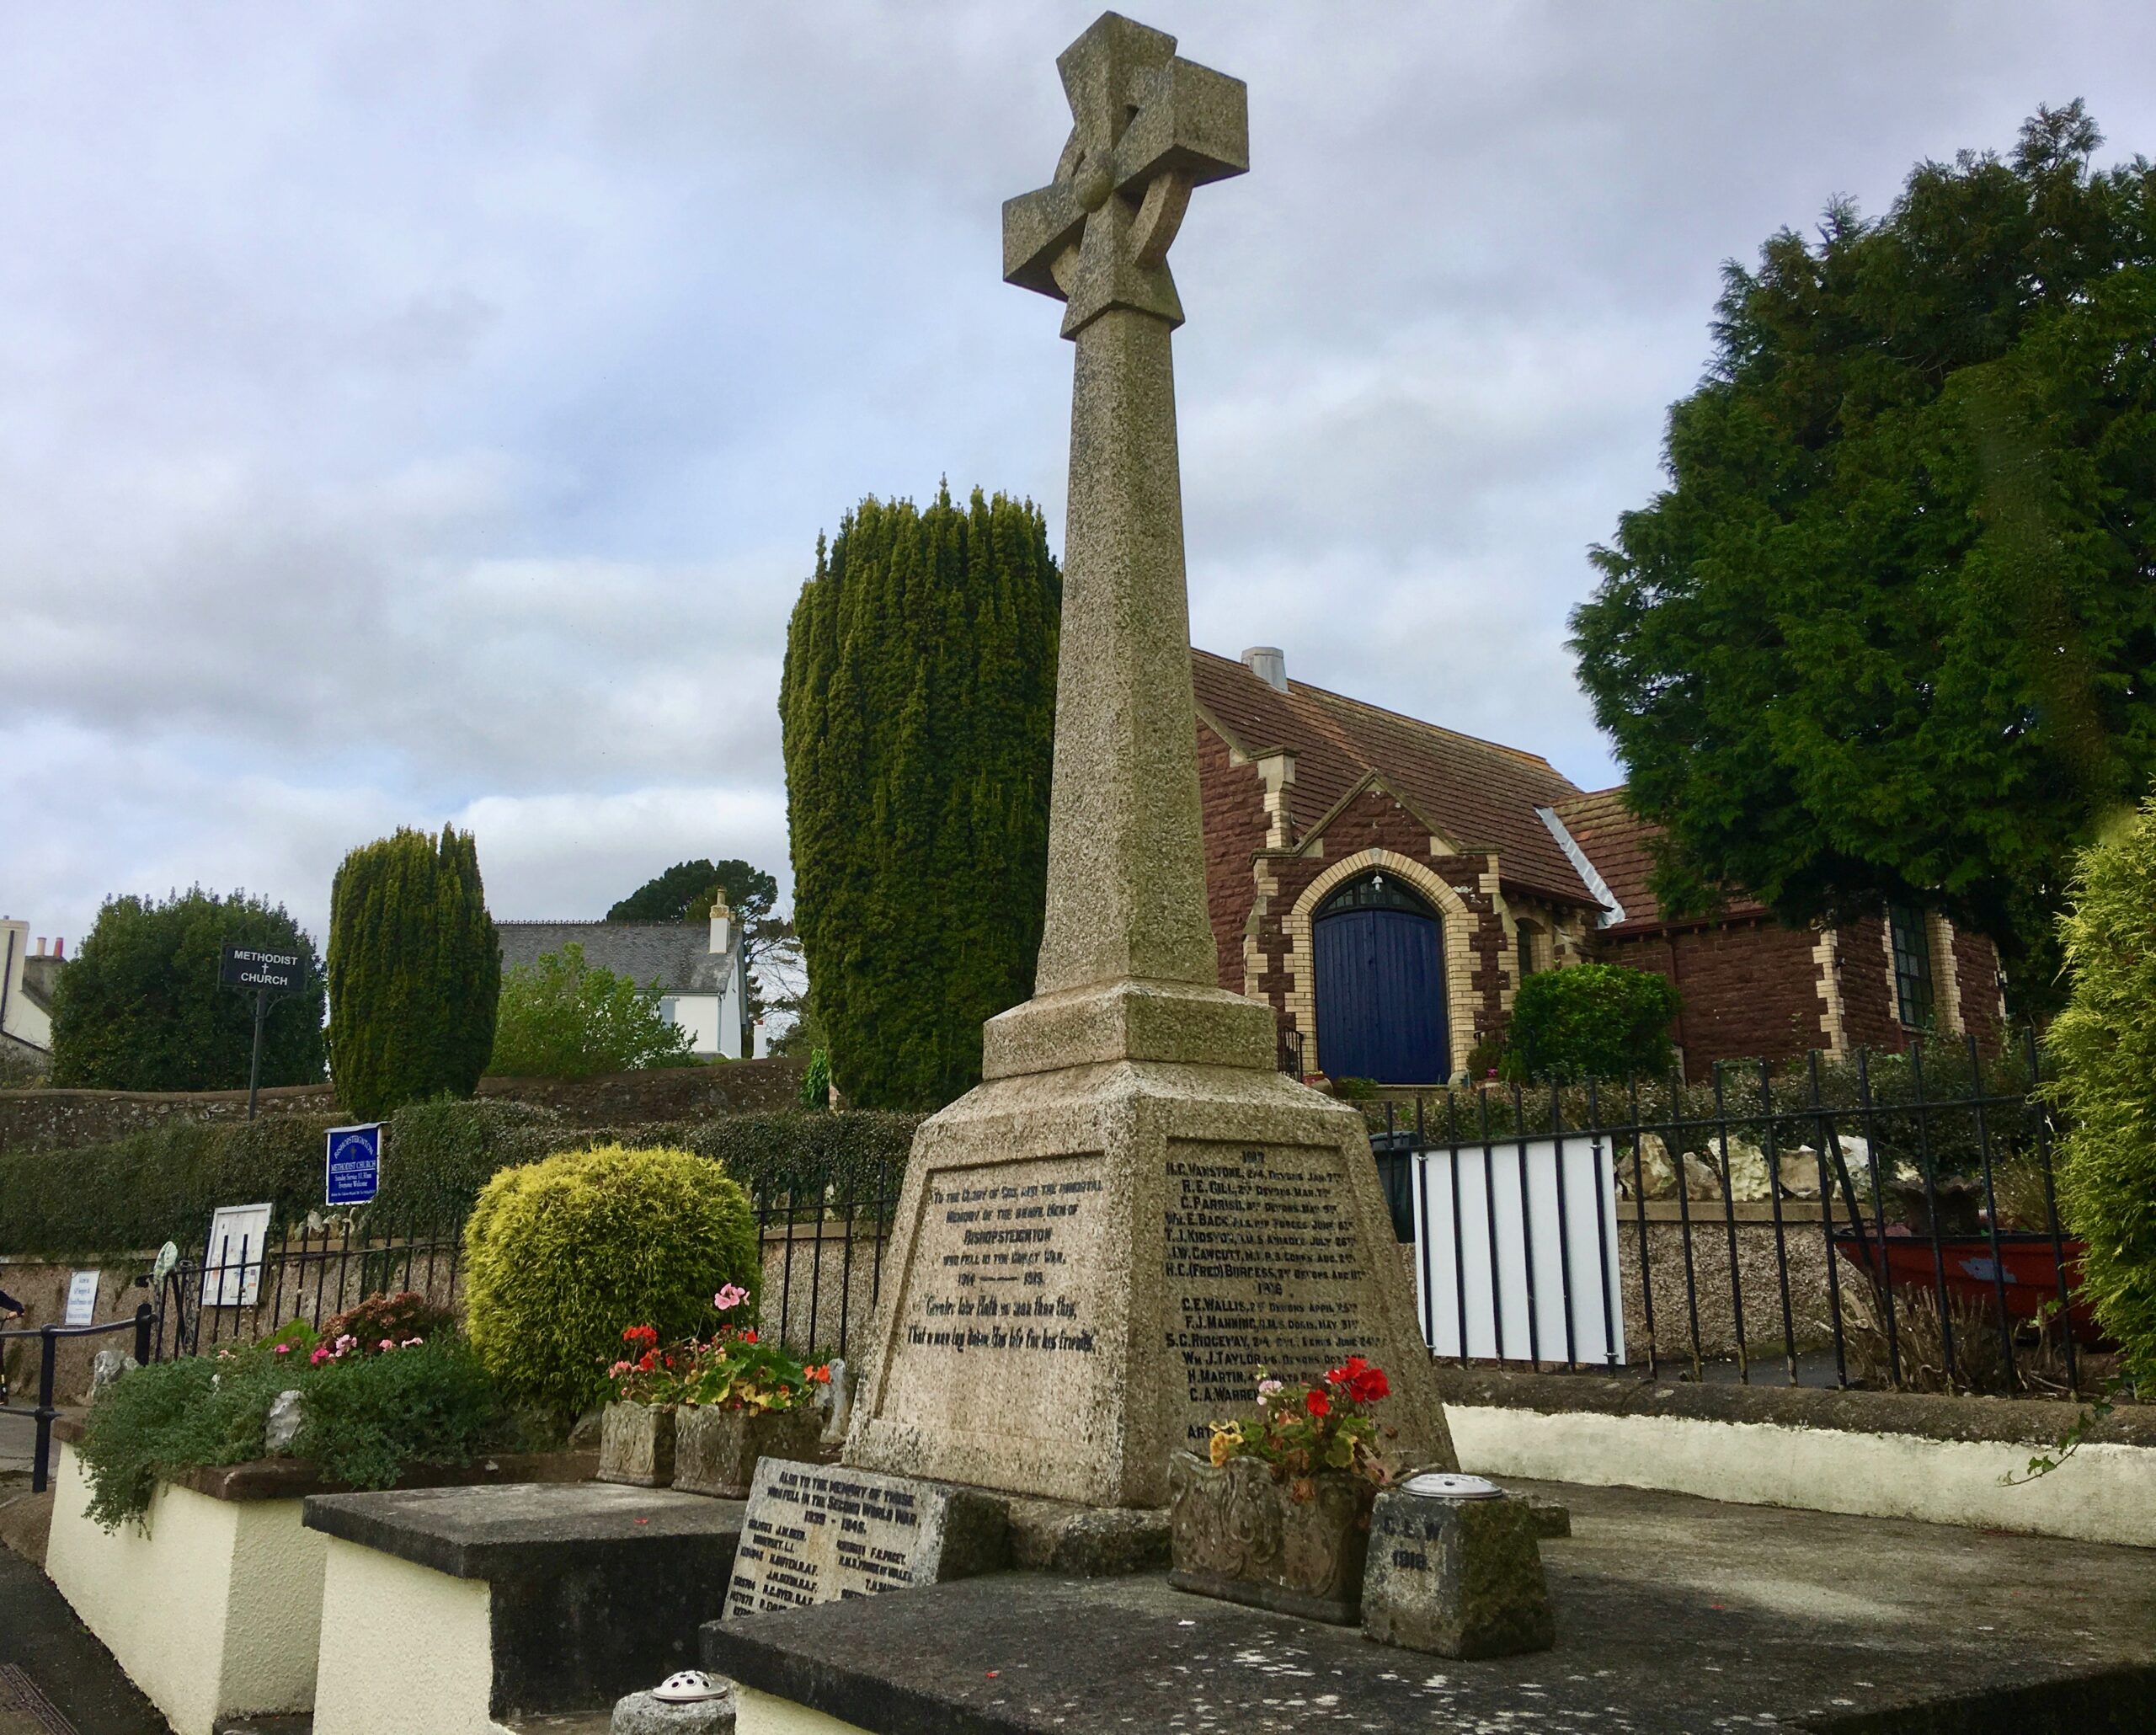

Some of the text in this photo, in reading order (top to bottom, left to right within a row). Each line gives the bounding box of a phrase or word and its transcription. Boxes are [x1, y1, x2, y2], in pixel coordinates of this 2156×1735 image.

[233, 950, 298, 966] METHODIST
[241, 972, 288, 985] CHURCH
[334, 1134, 374, 1160] BISHOPSTEIGNTON
[330, 1159, 376, 1172] METHODIST CHURCH
[963, 1228, 1053, 1246] BISHOPSTEIGNTON
[778, 1471, 916, 1508] ALSO TO THE MEMORY OF THOSE
[782, 1488, 800, 1503] FELL
[801, 1492, 811, 1506] IN
[812, 1494, 827, 1509] THE
[827, 1495, 861, 1516] SECOND
[862, 1502, 894, 1523] WORLD
[803, 1509, 827, 1526] 1939
